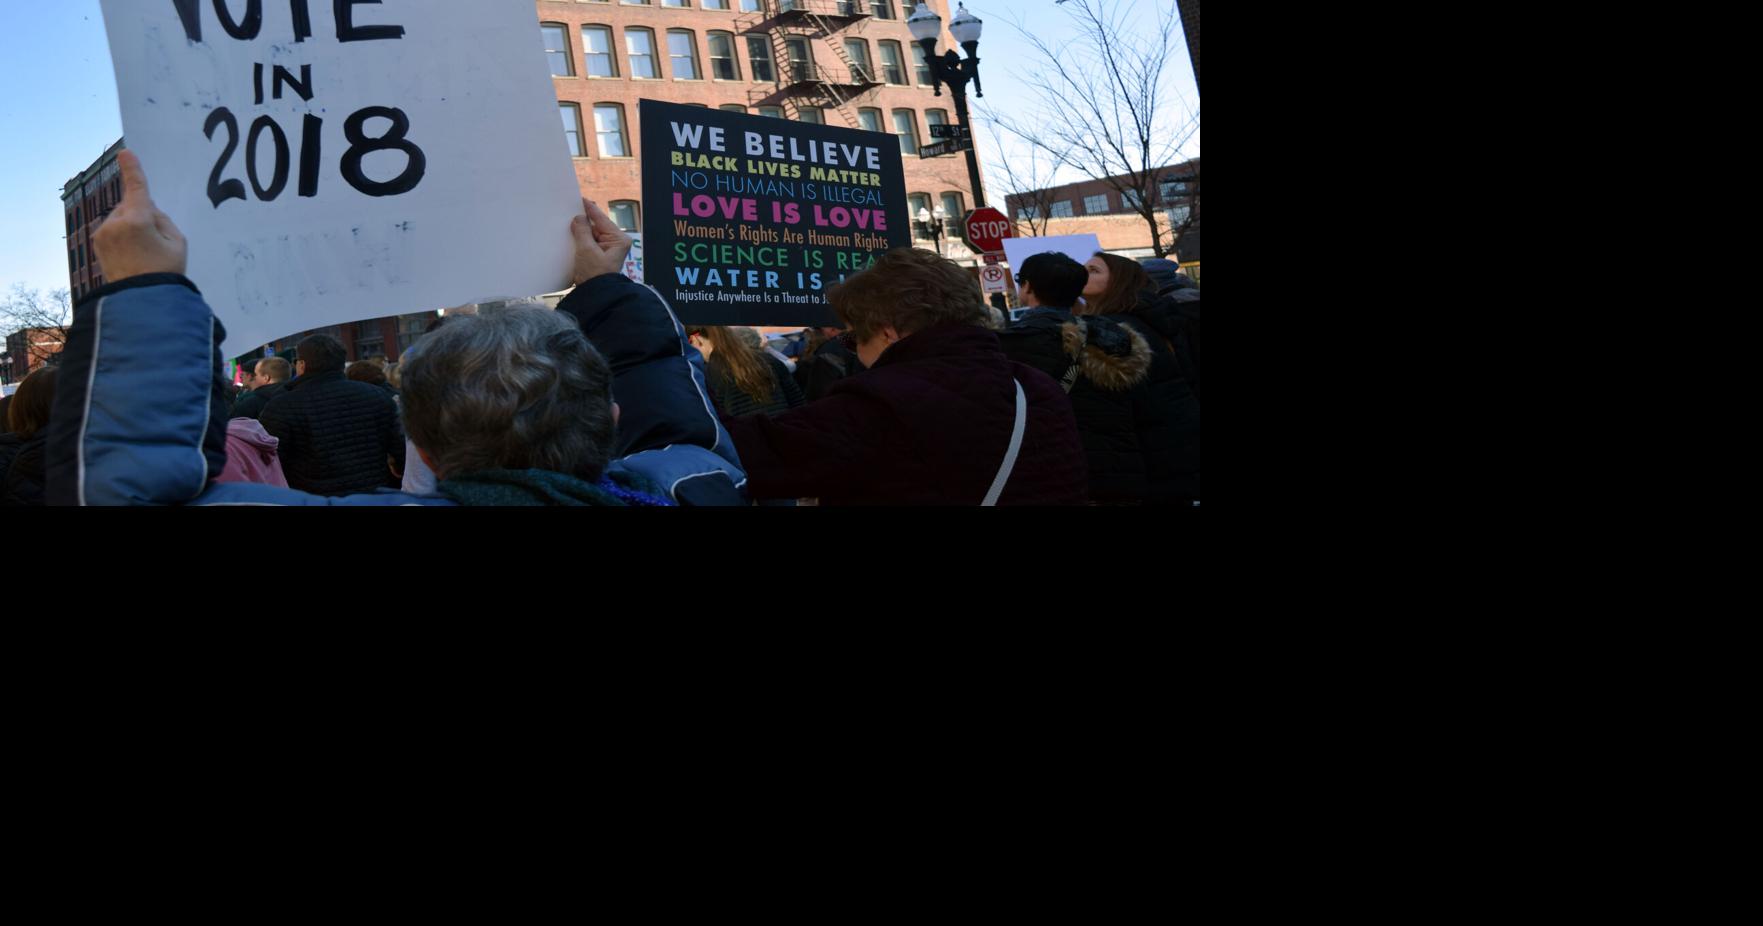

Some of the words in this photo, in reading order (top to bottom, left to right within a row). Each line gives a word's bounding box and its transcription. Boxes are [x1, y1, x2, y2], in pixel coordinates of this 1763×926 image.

[254, 62, 314, 105] IN
[203, 106, 426, 209] 2018
[670, 121, 726, 152] WE
[744, 131, 881, 170] BELIEVE
[671, 151, 738, 172] BLACK
[747, 160, 802, 179] LIVES
[809, 166, 882, 187] MATTER
[671, 170, 708, 190] NO
[716, 174, 795, 198] HUMAN
[801, 183, 817, 200] IS
[822, 184, 885, 206] ILLEGAL
[673, 192, 758, 221] LOVE
[772, 201, 801, 224] IS
[814, 204, 887, 231] LOVE
[674, 219, 735, 240] Women's
[740, 224, 779, 246] Rights
[783, 227, 804, 245] Are
[808, 228, 850, 248] Human
[854, 232, 889, 253] Rights
[970, 220, 1008, 240] STOP
[674, 242, 789, 267] SCIENCE
[803, 249, 824, 269] IS
[836, 251, 885, 271] REA
[674, 266, 780, 289] WATER
[797, 272, 822, 290] IS
[675, 289, 715, 304] Injustice
[717, 290, 761, 305] Anywhere
[764, 292, 771, 303] Is
[774, 295, 780, 303] a
[781, 291, 809, 304] Threat
[811, 293, 820, 304] to
